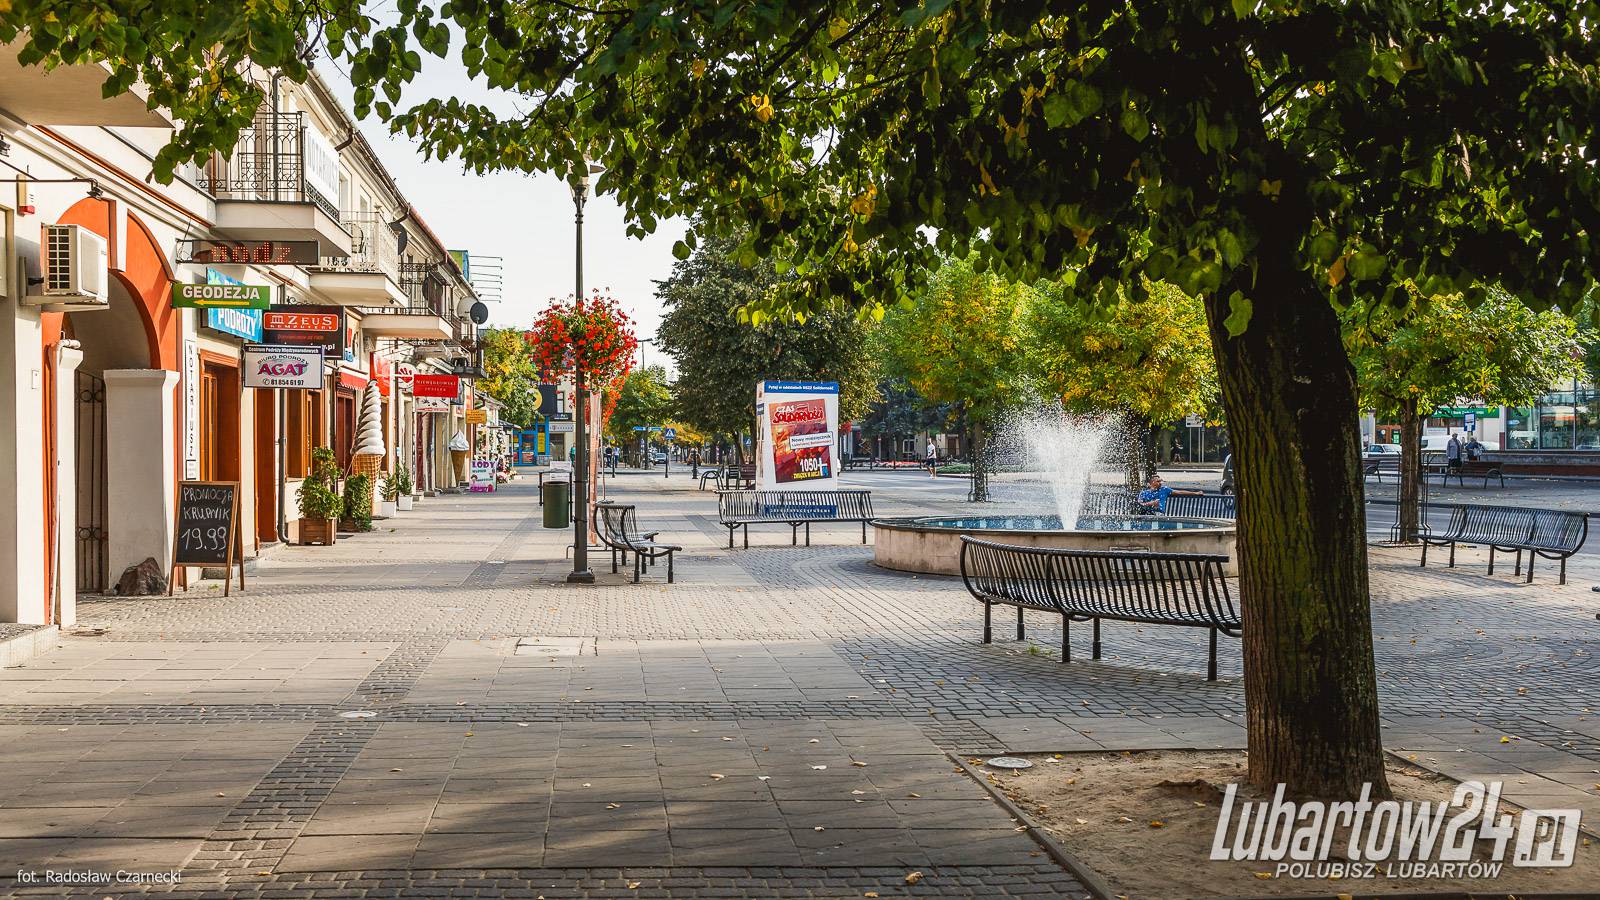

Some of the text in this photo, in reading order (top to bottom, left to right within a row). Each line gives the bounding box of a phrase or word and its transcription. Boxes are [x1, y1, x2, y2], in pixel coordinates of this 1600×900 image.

[182, 285, 260, 300] GEODEZJA
[287, 315, 332, 326] ZEUS
[257, 363, 309, 377] AGAT
[776, 404, 795, 413] CZAS
[183, 486, 233, 504] PROMOCJA
[183, 506, 231, 521] KRUPNIK
[180, 526, 227, 550] 19.99
